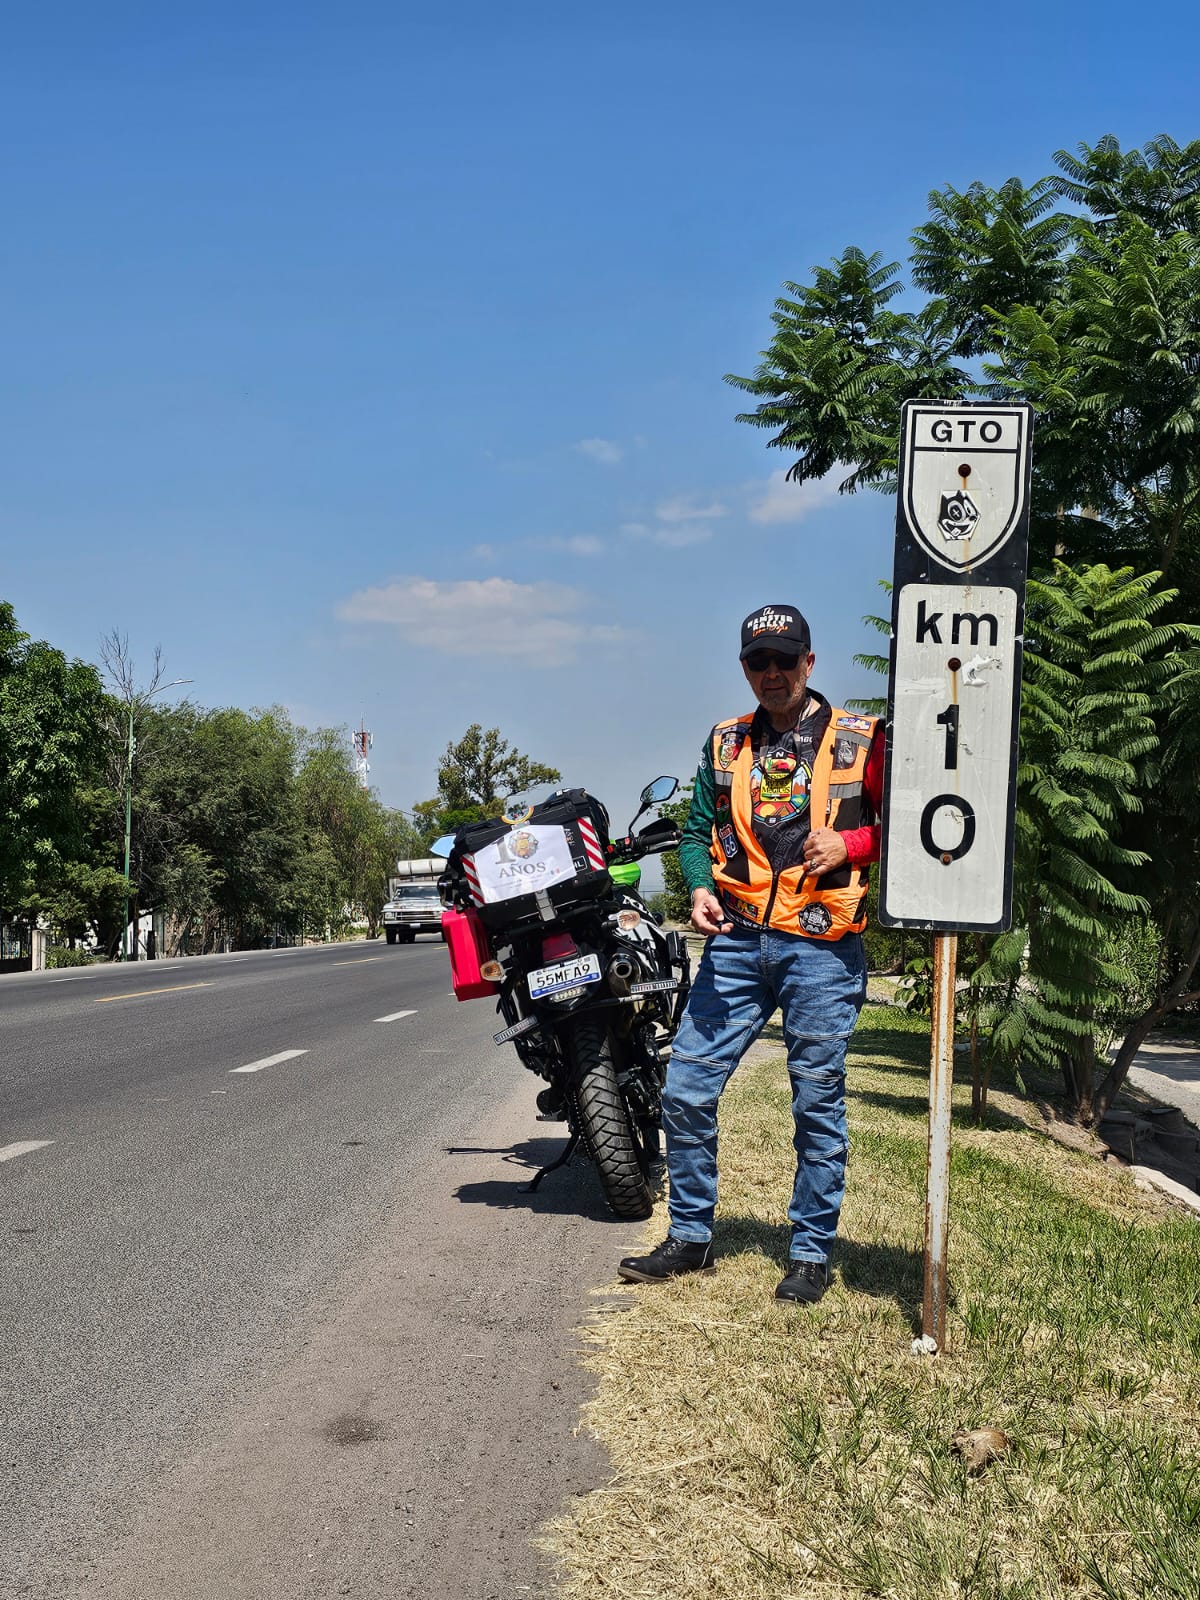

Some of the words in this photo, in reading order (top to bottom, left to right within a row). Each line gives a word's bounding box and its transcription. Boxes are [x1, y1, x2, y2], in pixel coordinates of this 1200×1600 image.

[931, 419, 1003, 443] GTO
[915, 599, 999, 647] km
[723, 837, 736, 855] 66
[499, 861, 547, 879] AÑOS
